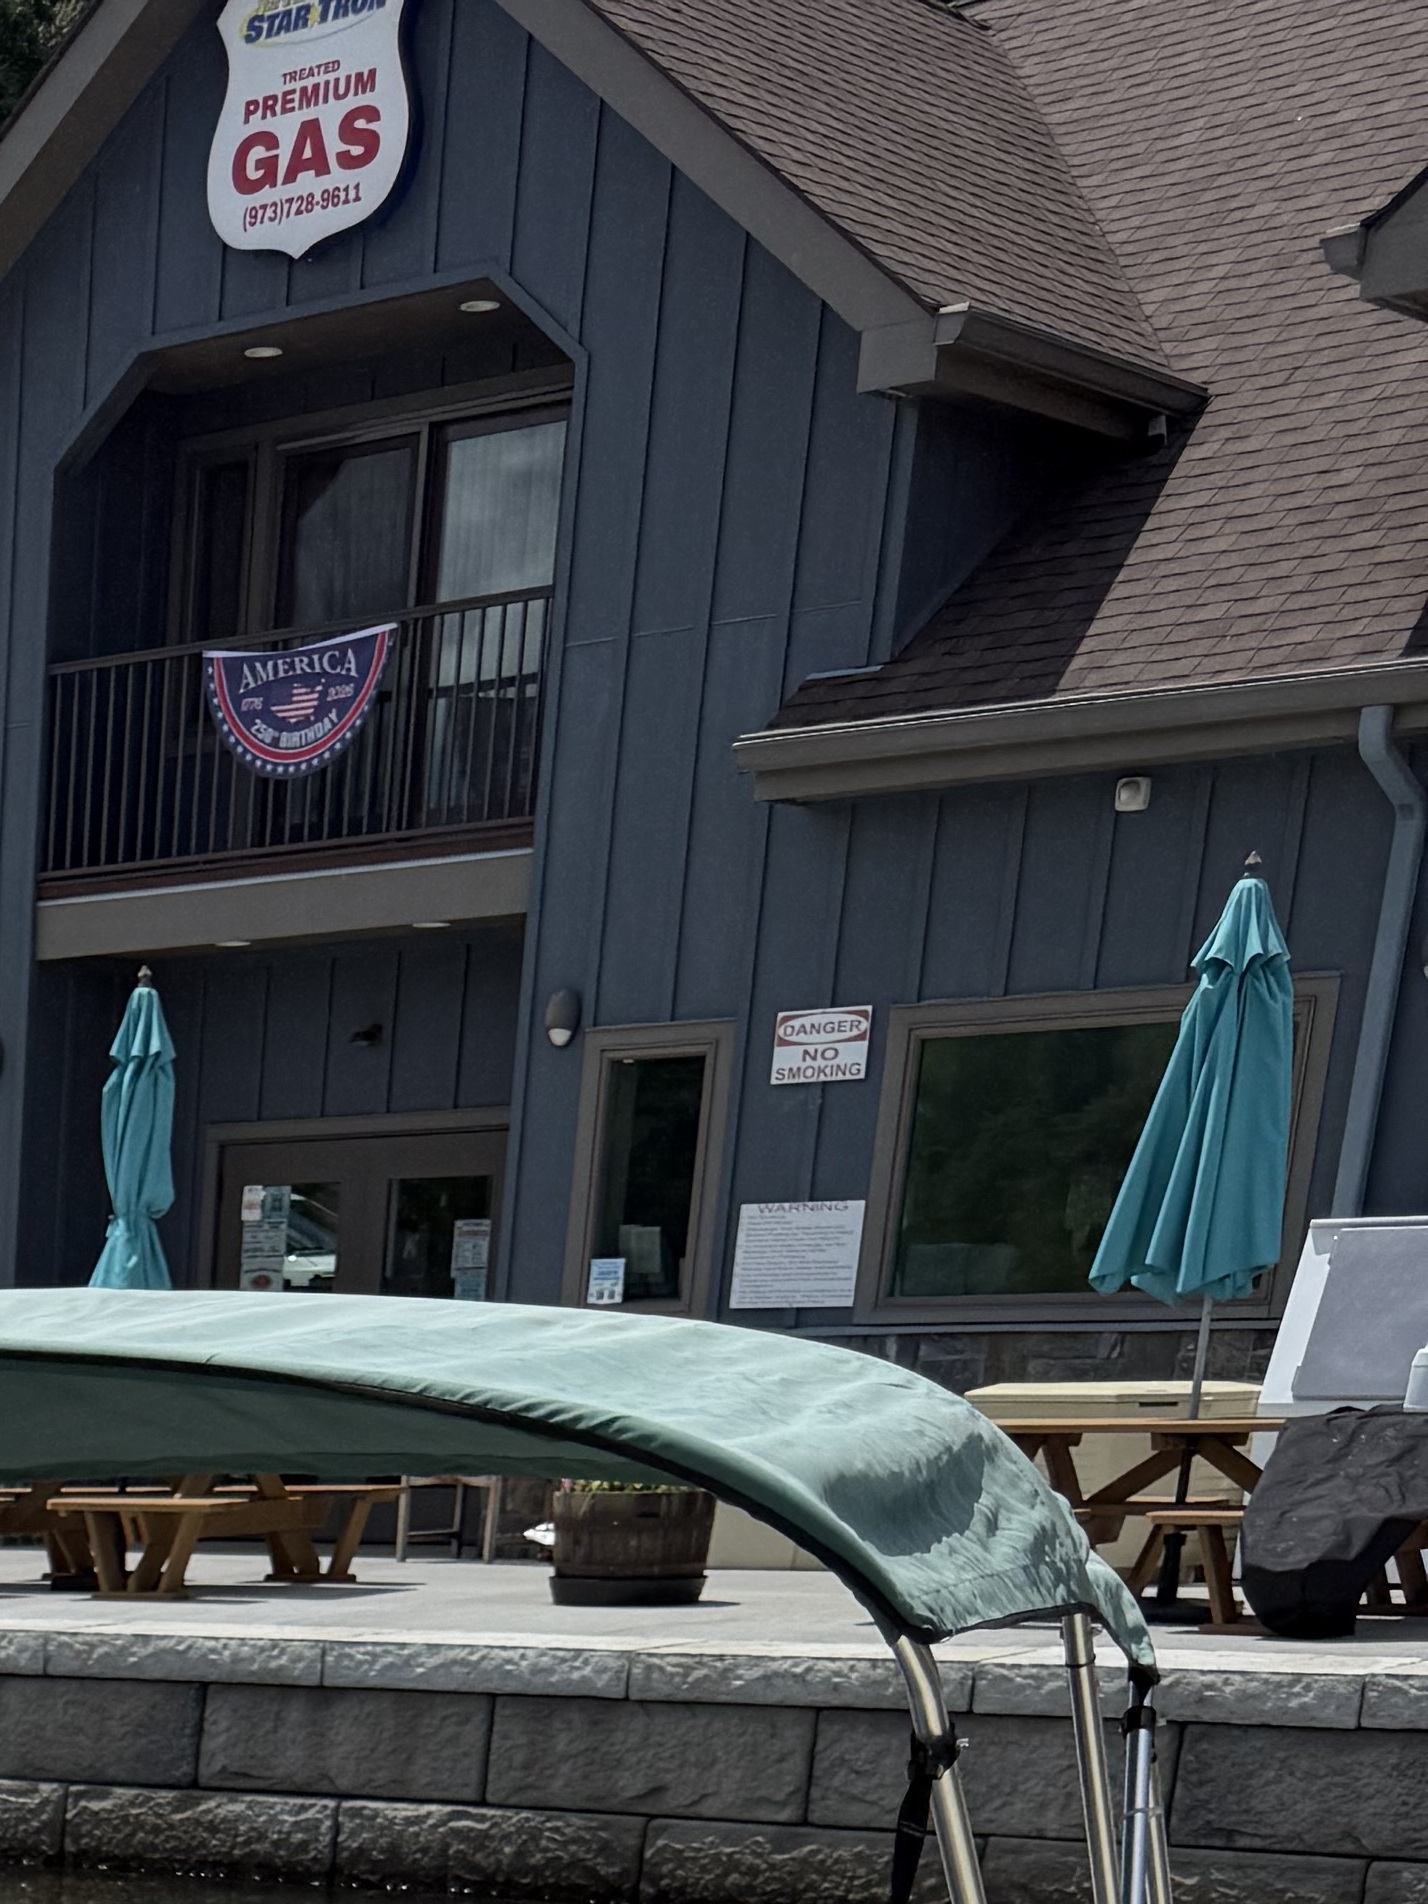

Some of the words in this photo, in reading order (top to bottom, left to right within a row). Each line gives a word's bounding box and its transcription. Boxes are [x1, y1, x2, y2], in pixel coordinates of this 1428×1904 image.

[244, 3, 312, 45] STAR
[281, 59, 341, 86] TREATED
[243, 68, 378, 125] PREMIUM
[231, 104, 382, 196] GAS
[242, 182, 363, 232] (973)728-9611
[238, 648, 359, 695] AMERICA
[783, 1019, 863, 1038] DANGER
[775, 1062, 862, 1082] SMOKING
[801, 1047, 840, 1063] NO
[757, 1201, 849, 1214] WARNING
